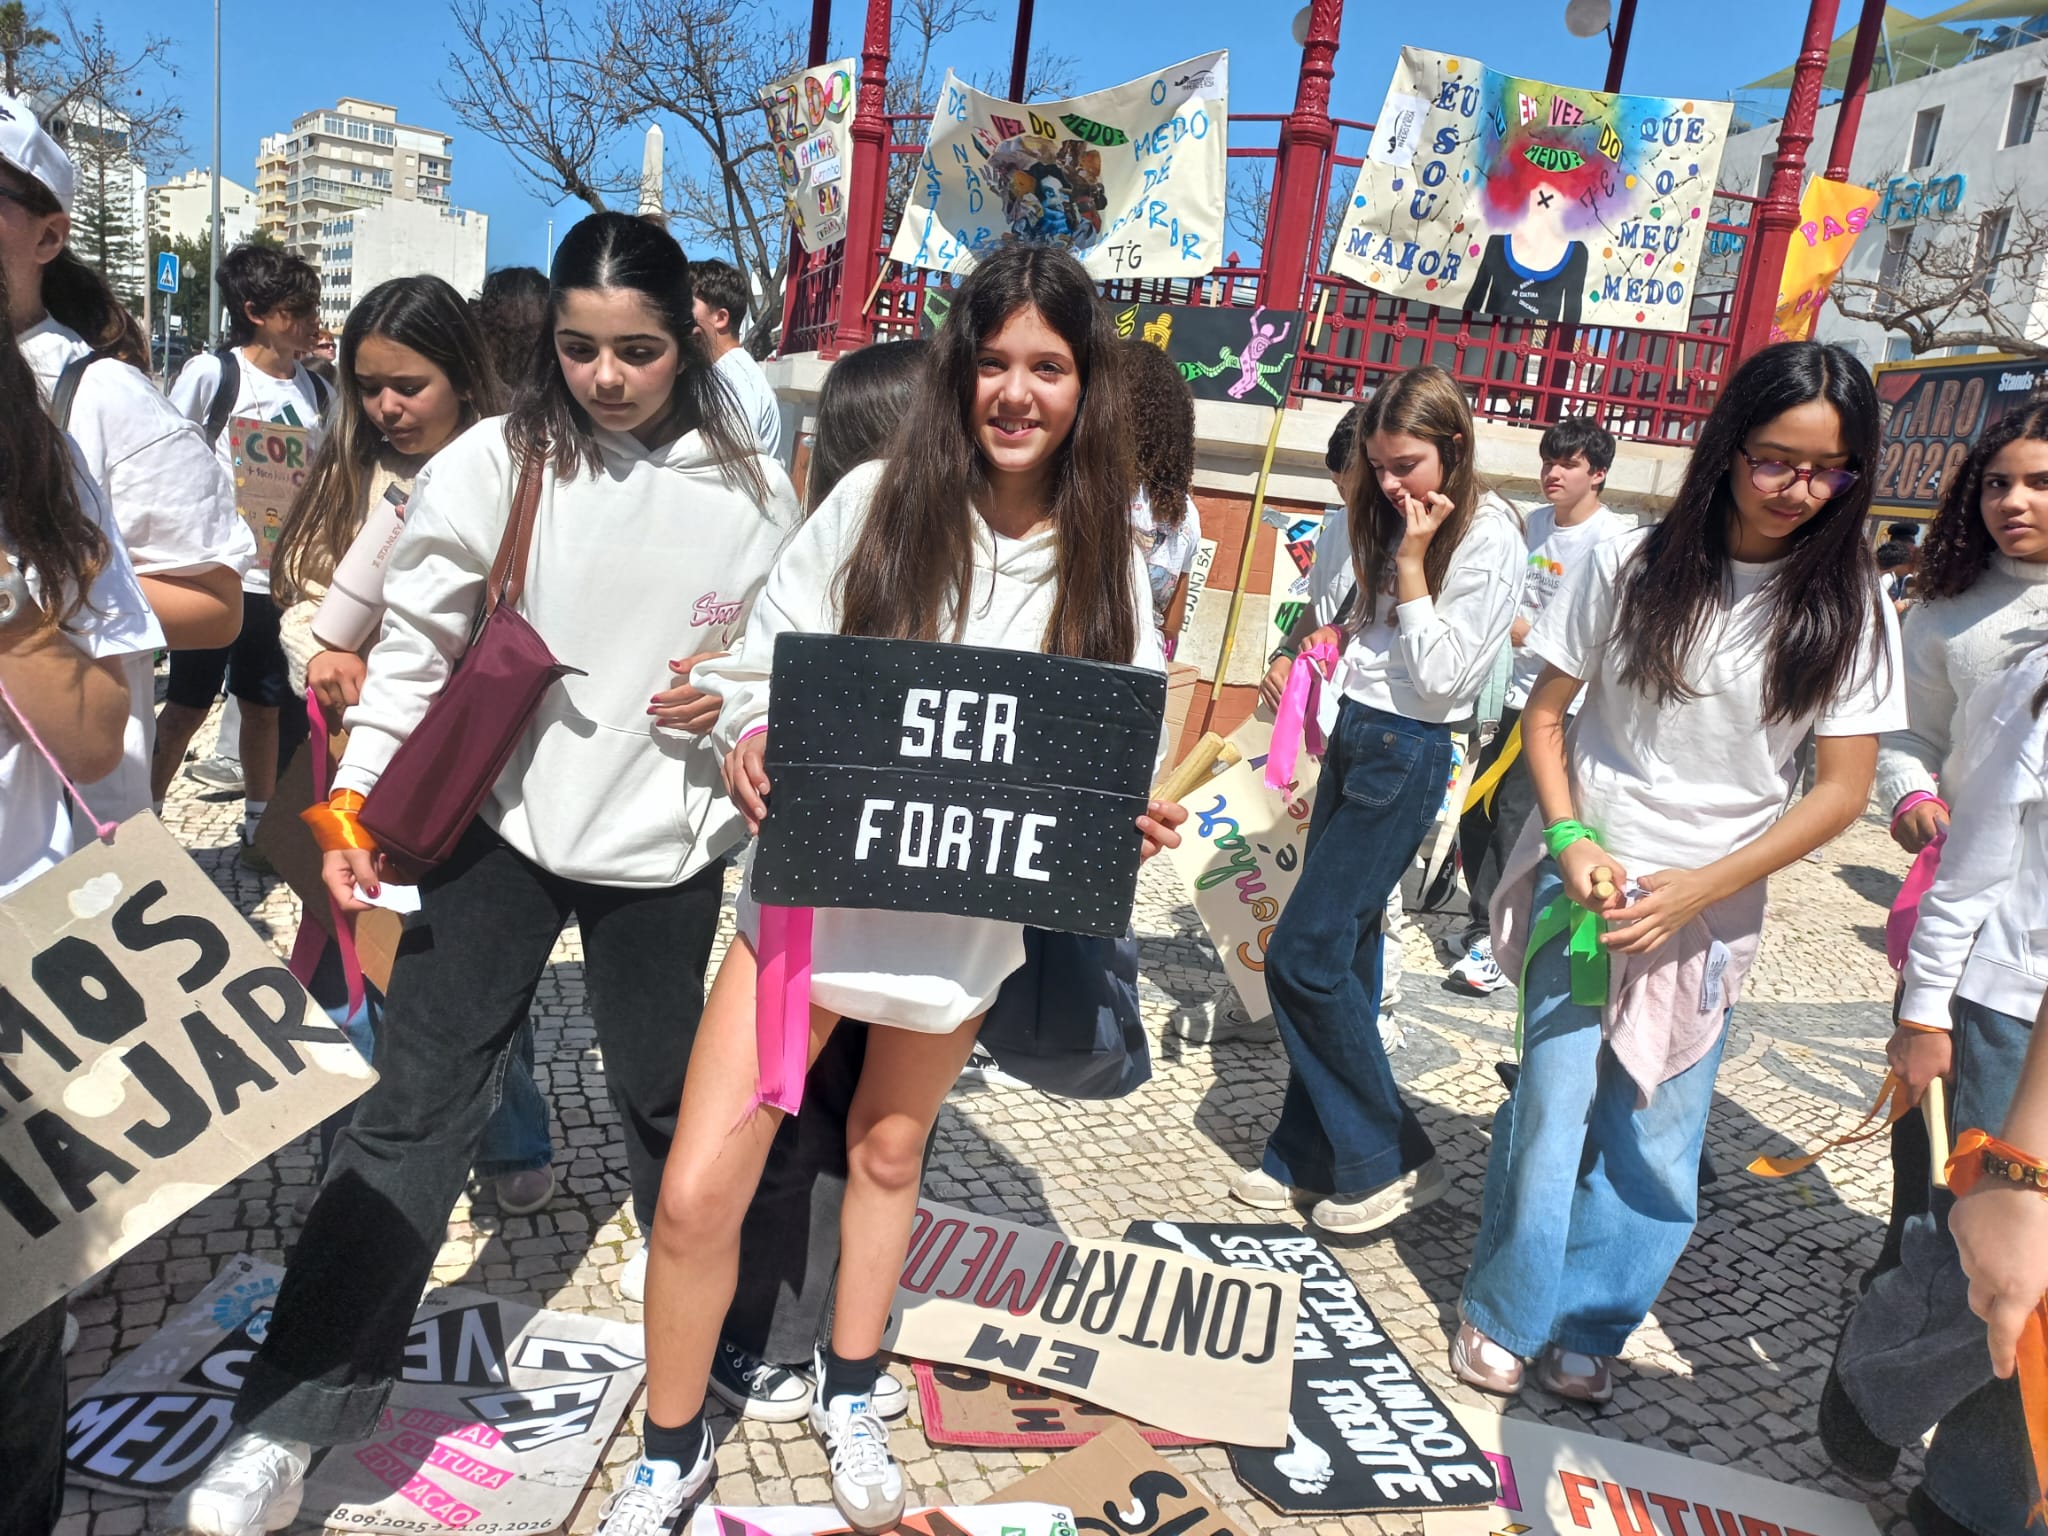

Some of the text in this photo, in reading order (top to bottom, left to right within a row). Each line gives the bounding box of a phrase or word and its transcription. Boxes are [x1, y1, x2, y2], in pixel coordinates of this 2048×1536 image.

[1151, 79, 1167, 106] O
[1436, 81, 1480, 118] EU
[1551, 95, 1585, 126] VEZ
[1030, 113, 1056, 139] DO
[1133, 110, 1209, 161] MEDO
[1598, 121, 1622, 161] DO
[1640, 117, 1706, 147] QUE
[1524, 145, 1582, 171] MEDO?
[1656, 170, 1676, 196] O
[1346, 228, 1461, 282] MAIOR
[1619, 221, 1684, 254] MEU
[1602, 274, 1685, 306] MEDO
[377, 523, 404, 562] STANLEY
[900, 688, 1018, 764] SER
[854, 799, 1057, 881] FORTE
[1040, 1245, 1282, 1364] CONTRA
[964, 1322, 1100, 1390] EM
[1349, 1352, 1468, 1458] FUNDO
[405, 1411, 494, 1449] BIENAL
[1307, 1379, 1444, 1503] FRENTE
[397, 1432, 503, 1489] CULTURA
[358, 1447, 475, 1527] EDUCAÇÃO
[1559, 1470, 1815, 1536] FUTU
[328, 1508, 430, 1534] 8.09.2025
